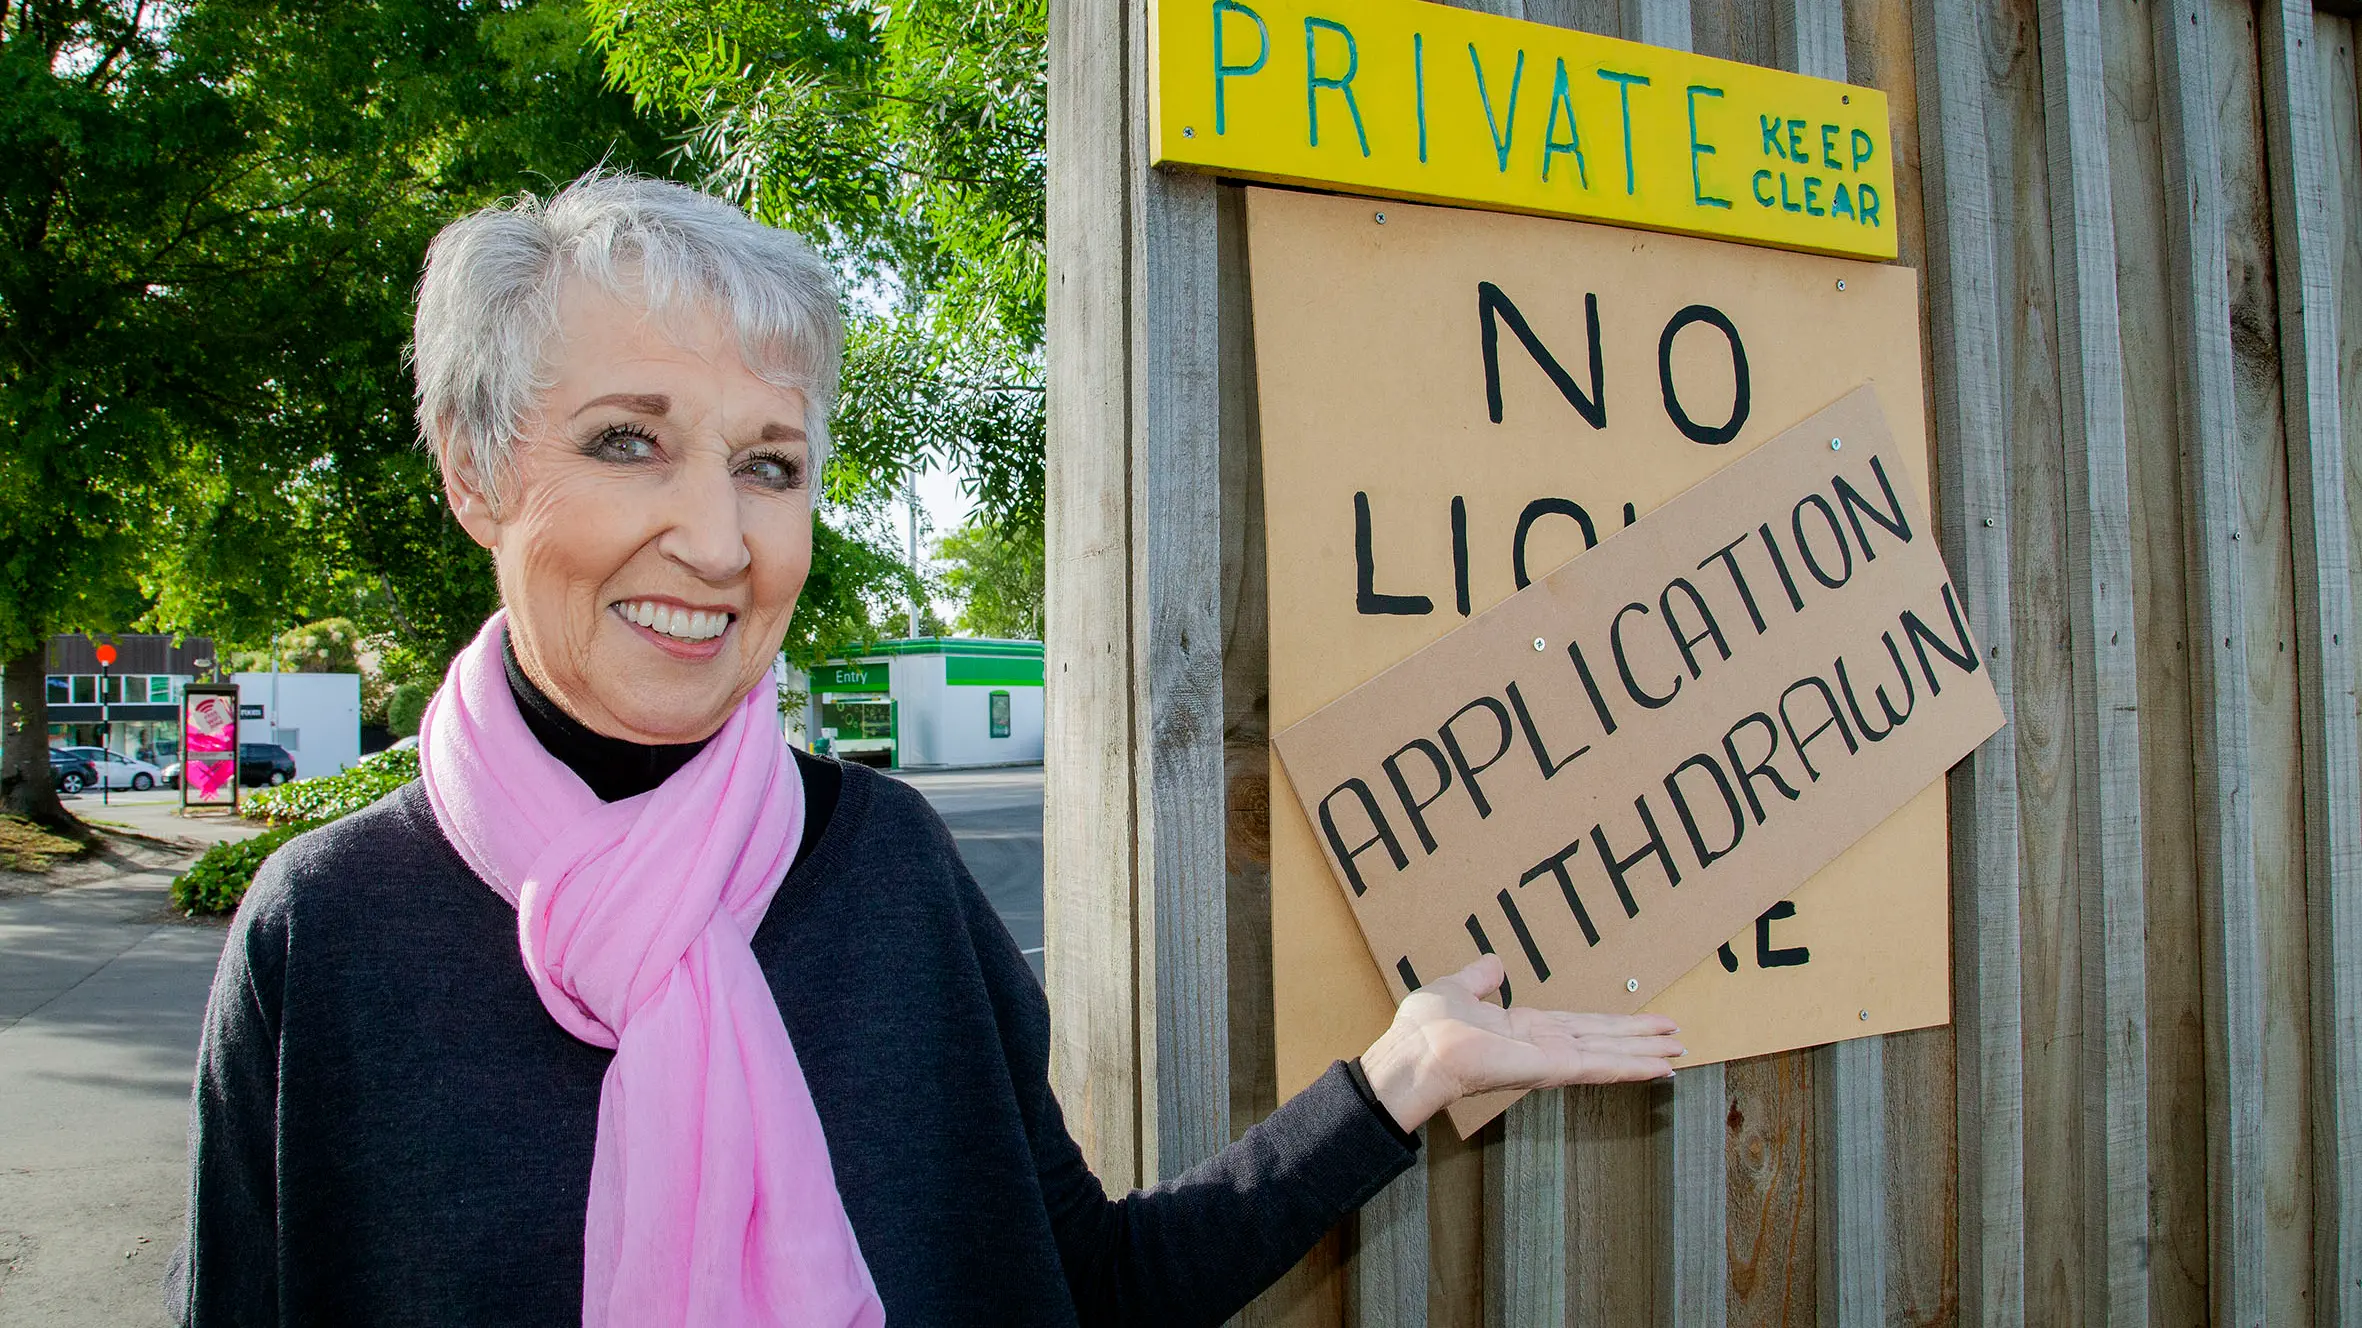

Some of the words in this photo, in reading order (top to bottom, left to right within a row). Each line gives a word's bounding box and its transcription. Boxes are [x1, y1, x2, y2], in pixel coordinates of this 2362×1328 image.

[1213, 0, 1732, 209] PRIVATE
[1760, 114, 1873, 172] KEEP
[1752, 169, 1880, 227] CLEAR
[1478, 281, 1750, 445] NO
[835, 669, 868, 685] Entry
[1318, 455, 1912, 897] APPLICATION
